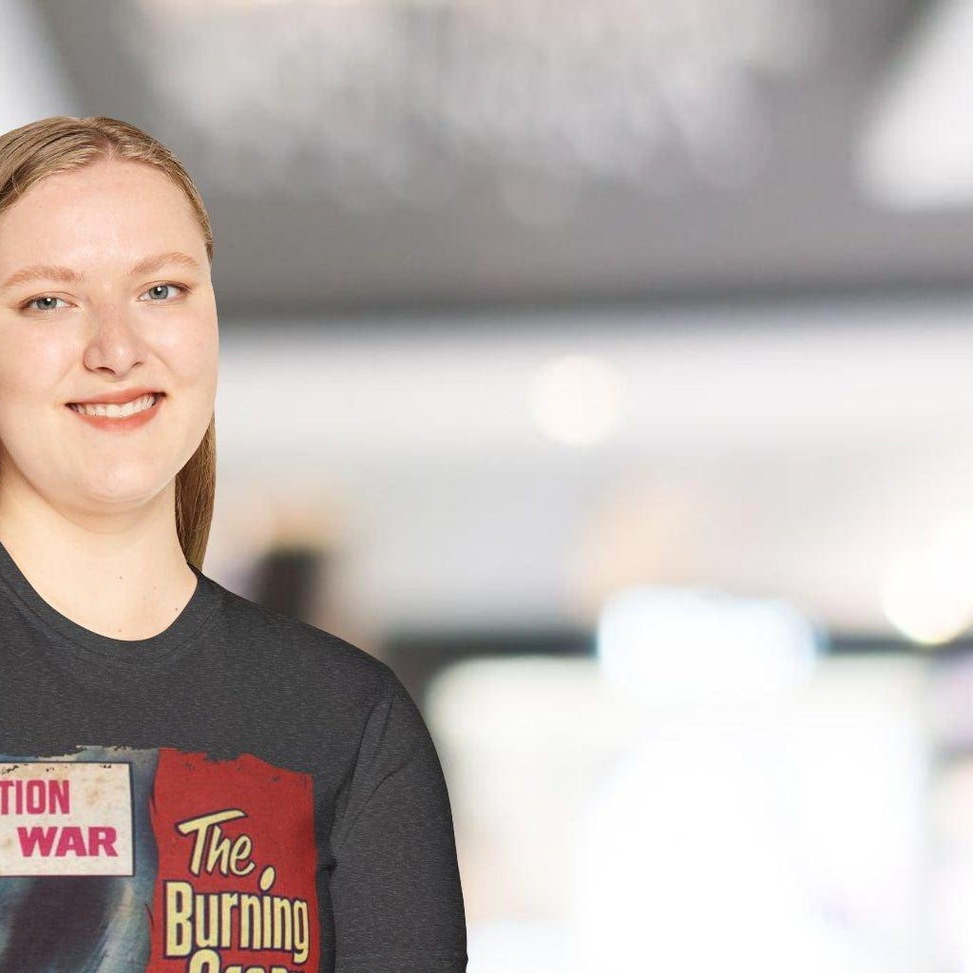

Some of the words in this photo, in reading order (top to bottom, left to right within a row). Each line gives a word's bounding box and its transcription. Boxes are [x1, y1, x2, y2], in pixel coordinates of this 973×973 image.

[17, 826, 118, 857] WAR
[176, 808, 254, 876] The
[164, 866, 309, 964] Burning
